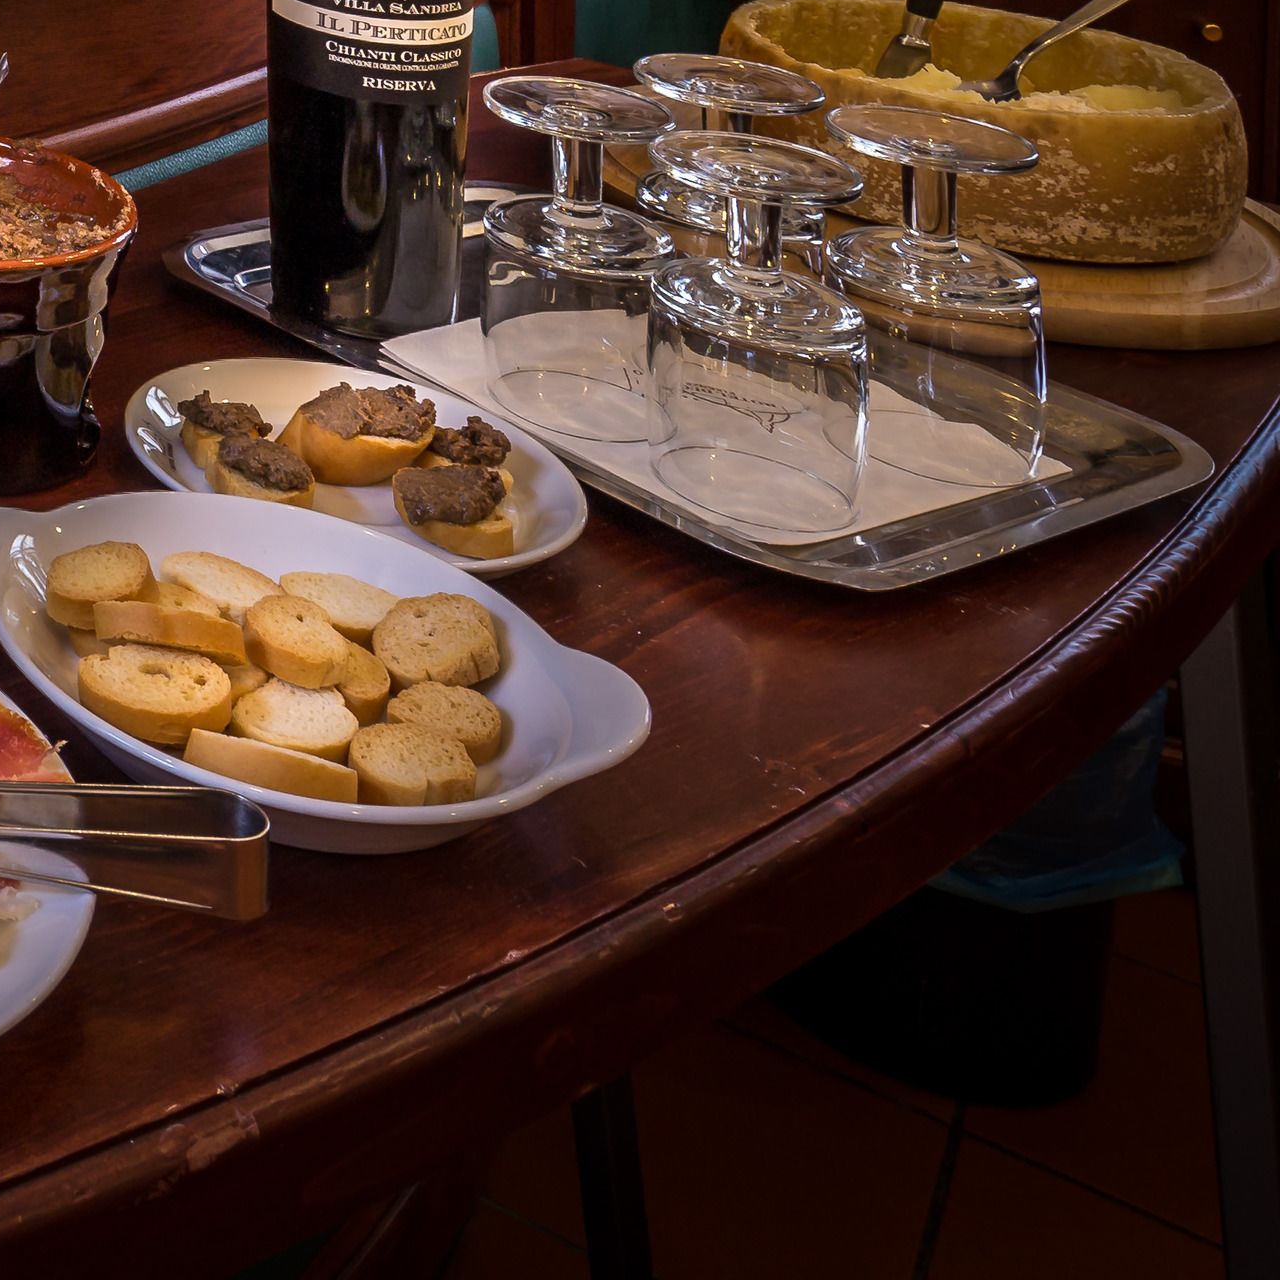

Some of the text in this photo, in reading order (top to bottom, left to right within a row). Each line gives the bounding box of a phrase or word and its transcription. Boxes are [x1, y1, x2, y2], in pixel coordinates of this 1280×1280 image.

[316, 11, 467, 42] IL PERTICATO
[325, 40, 462, 63] CHIANTI CLASSICO
[362, 76, 437, 91] RISERVA
